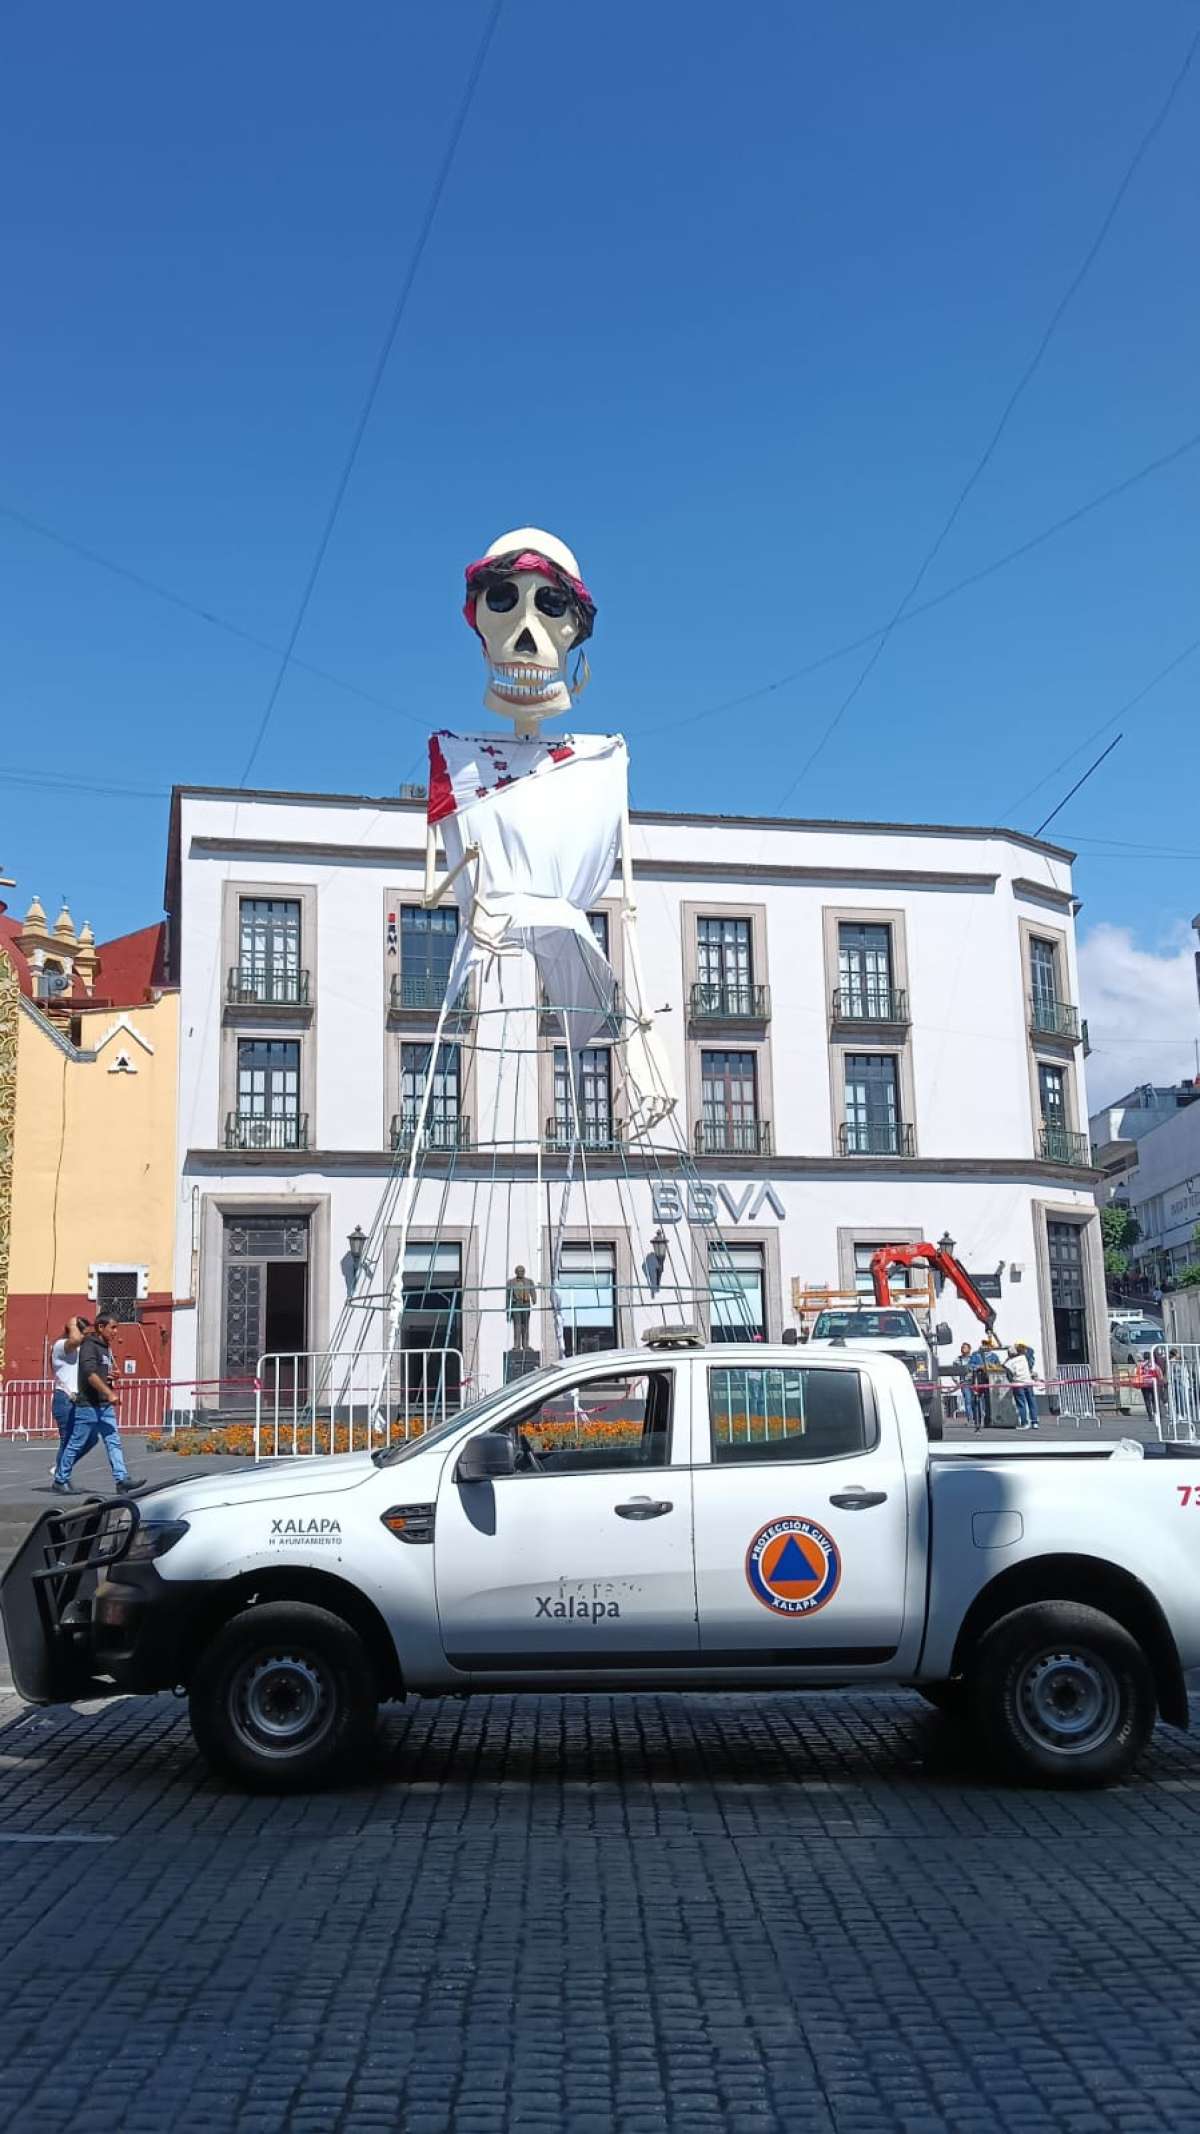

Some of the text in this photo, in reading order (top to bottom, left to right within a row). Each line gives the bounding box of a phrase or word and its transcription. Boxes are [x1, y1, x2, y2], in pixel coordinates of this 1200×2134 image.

[653, 1180, 785, 1224] BBVA
[271, 1518, 341, 1533] XALAPA
[811, 1529, 833, 1557] CIVIL
[535, 1595, 620, 1624] Xalapa
[772, 1598, 818, 1612] XALAPA
